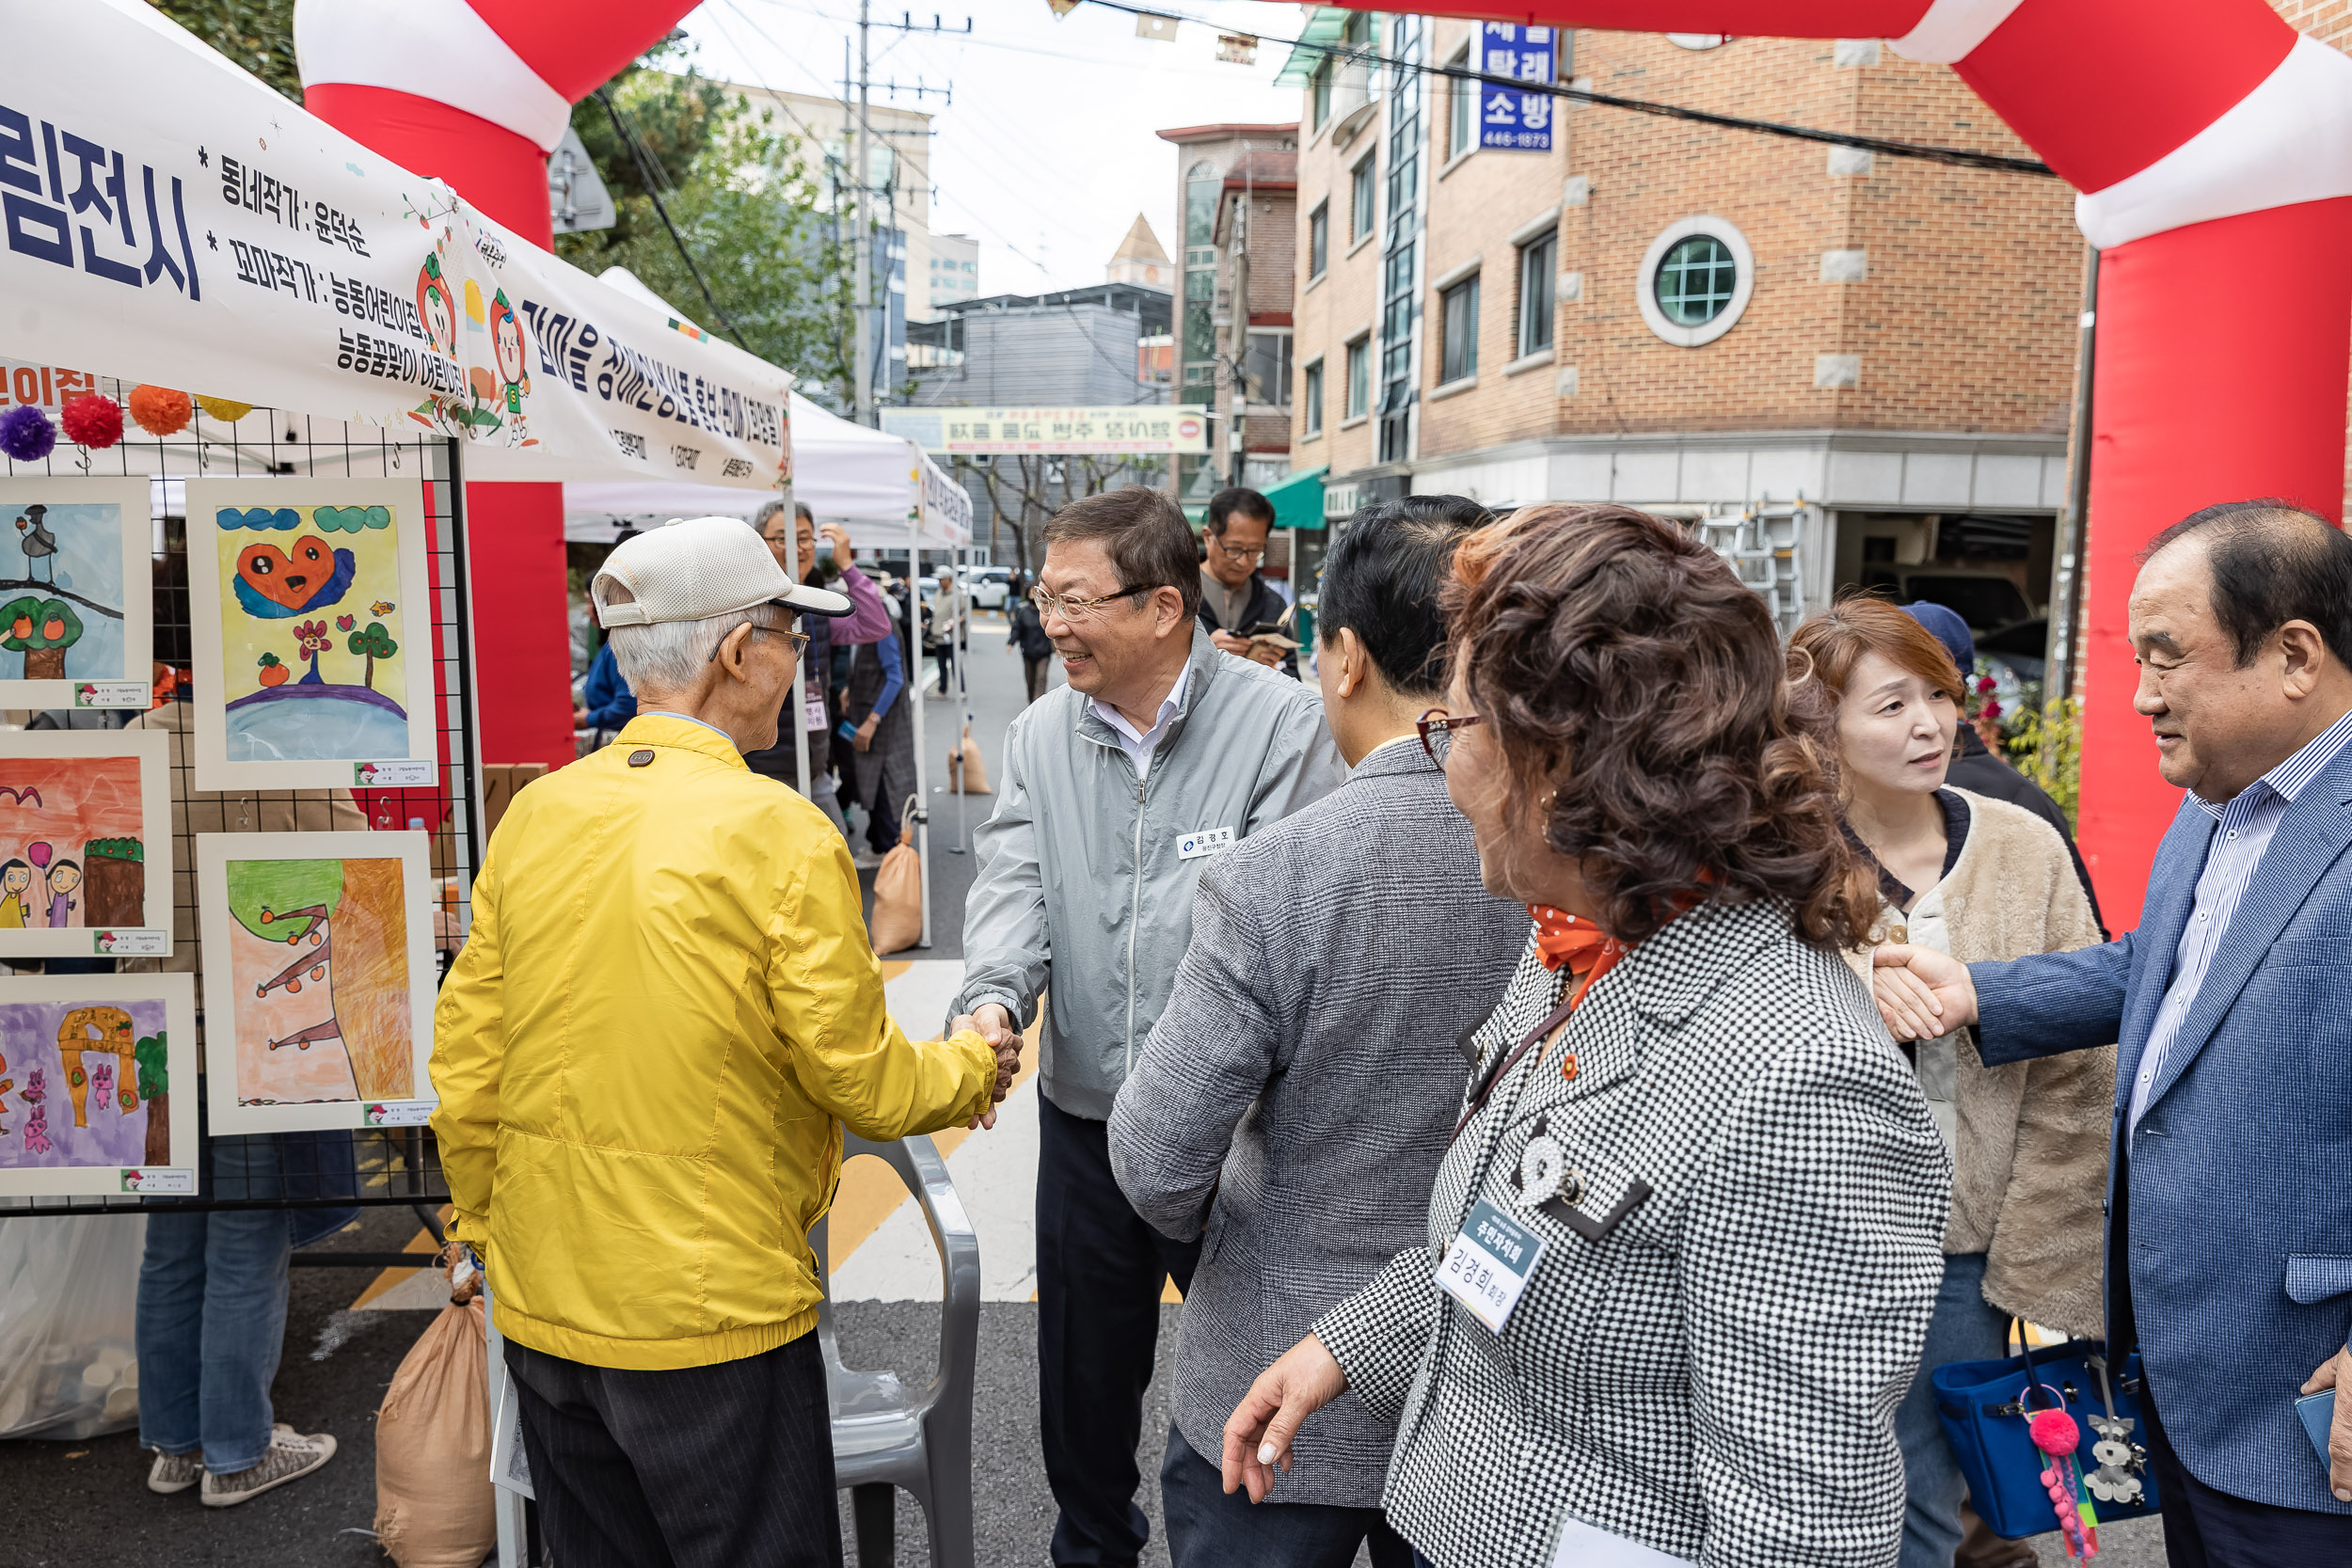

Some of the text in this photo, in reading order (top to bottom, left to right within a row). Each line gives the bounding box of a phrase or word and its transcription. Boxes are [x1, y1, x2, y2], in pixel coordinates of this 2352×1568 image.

[221, 153, 300, 232] 동네작가
[314, 200, 373, 259] 윤덕순
[229, 238, 318, 304] 꼬마작가
[336, 326, 418, 384] 능동꿈맞이
[0, 366, 96, 406] 이집
[1476, 1220, 1524, 1265] 주민자치회
[1450, 1248, 1494, 1295] 김경희
